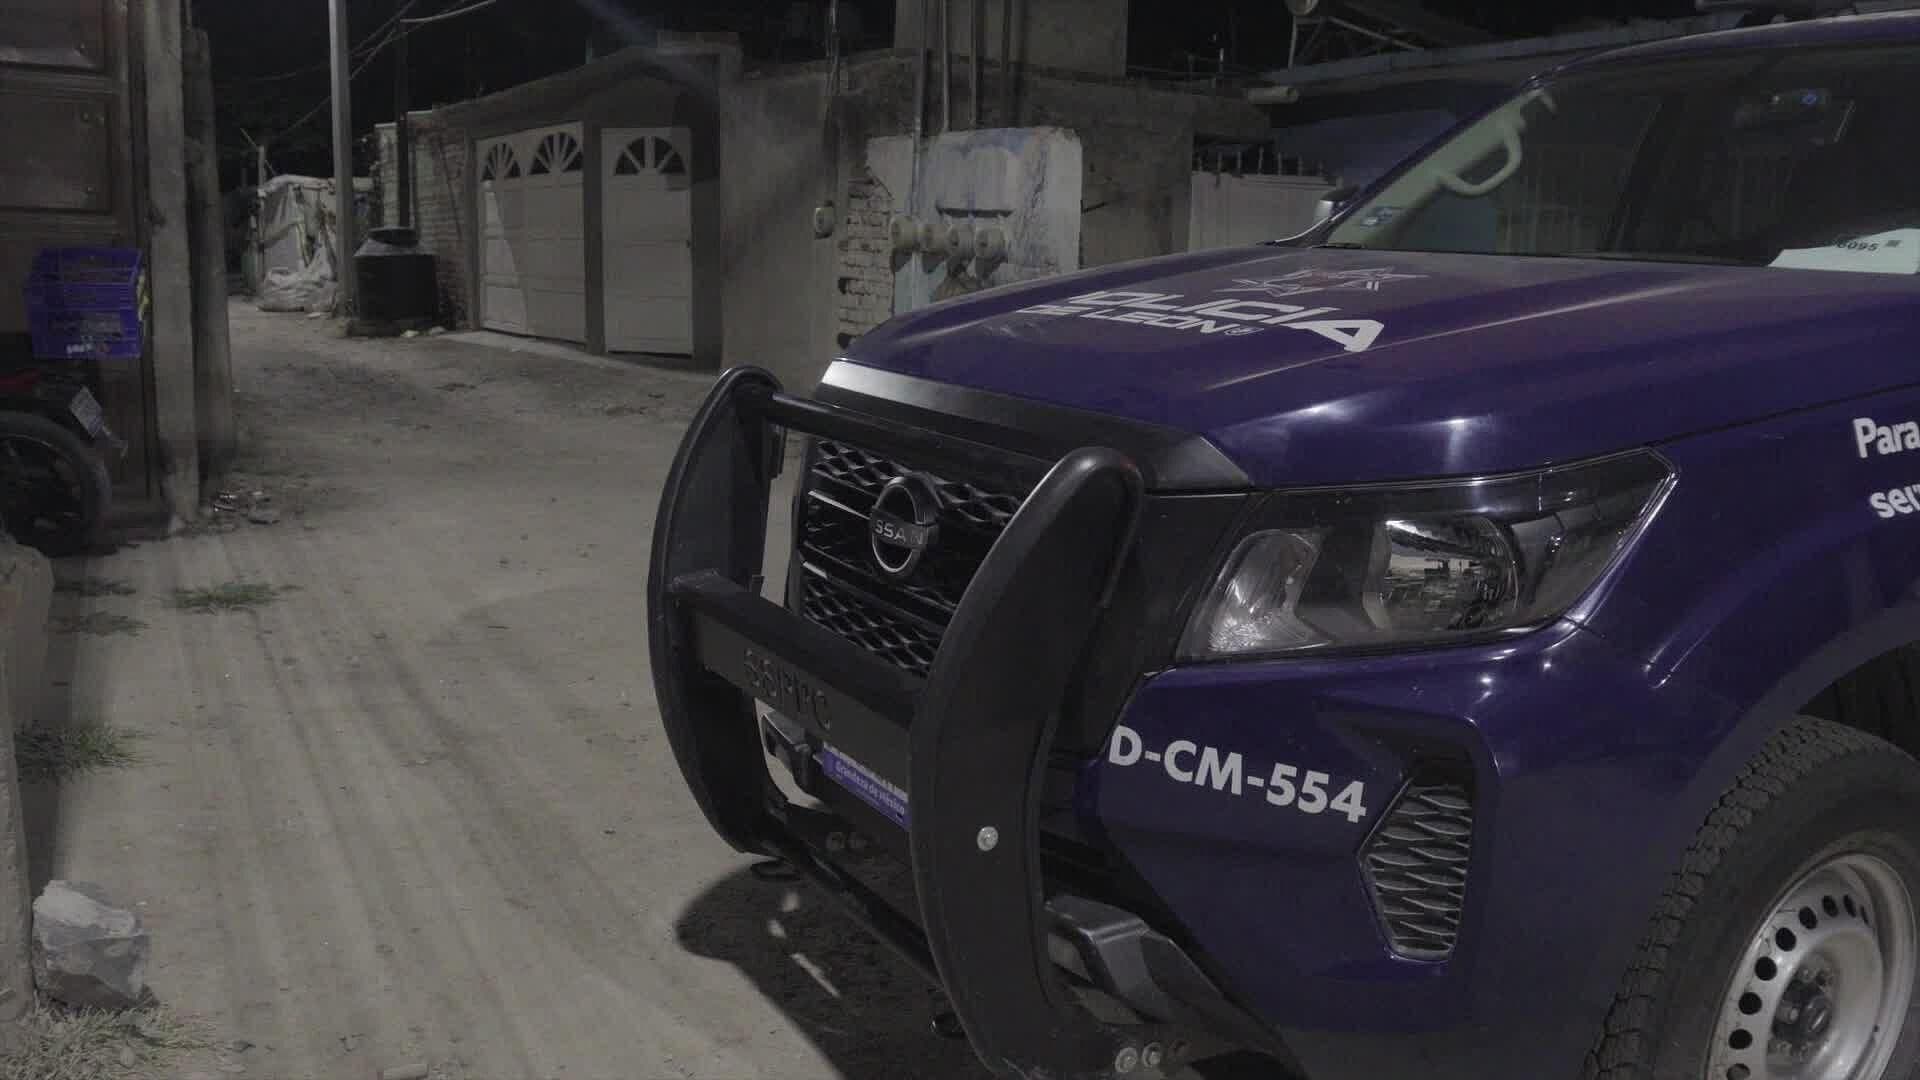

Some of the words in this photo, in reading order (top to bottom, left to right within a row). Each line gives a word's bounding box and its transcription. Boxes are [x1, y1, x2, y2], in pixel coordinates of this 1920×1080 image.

[1015, 304, 1095, 316] DE
[1066, 290, 1385, 353] OLICIA
[1852, 417, 1920, 459] Para
[874, 519, 924, 545] SSAN
[1107, 725, 1366, 824] D-CM-554
